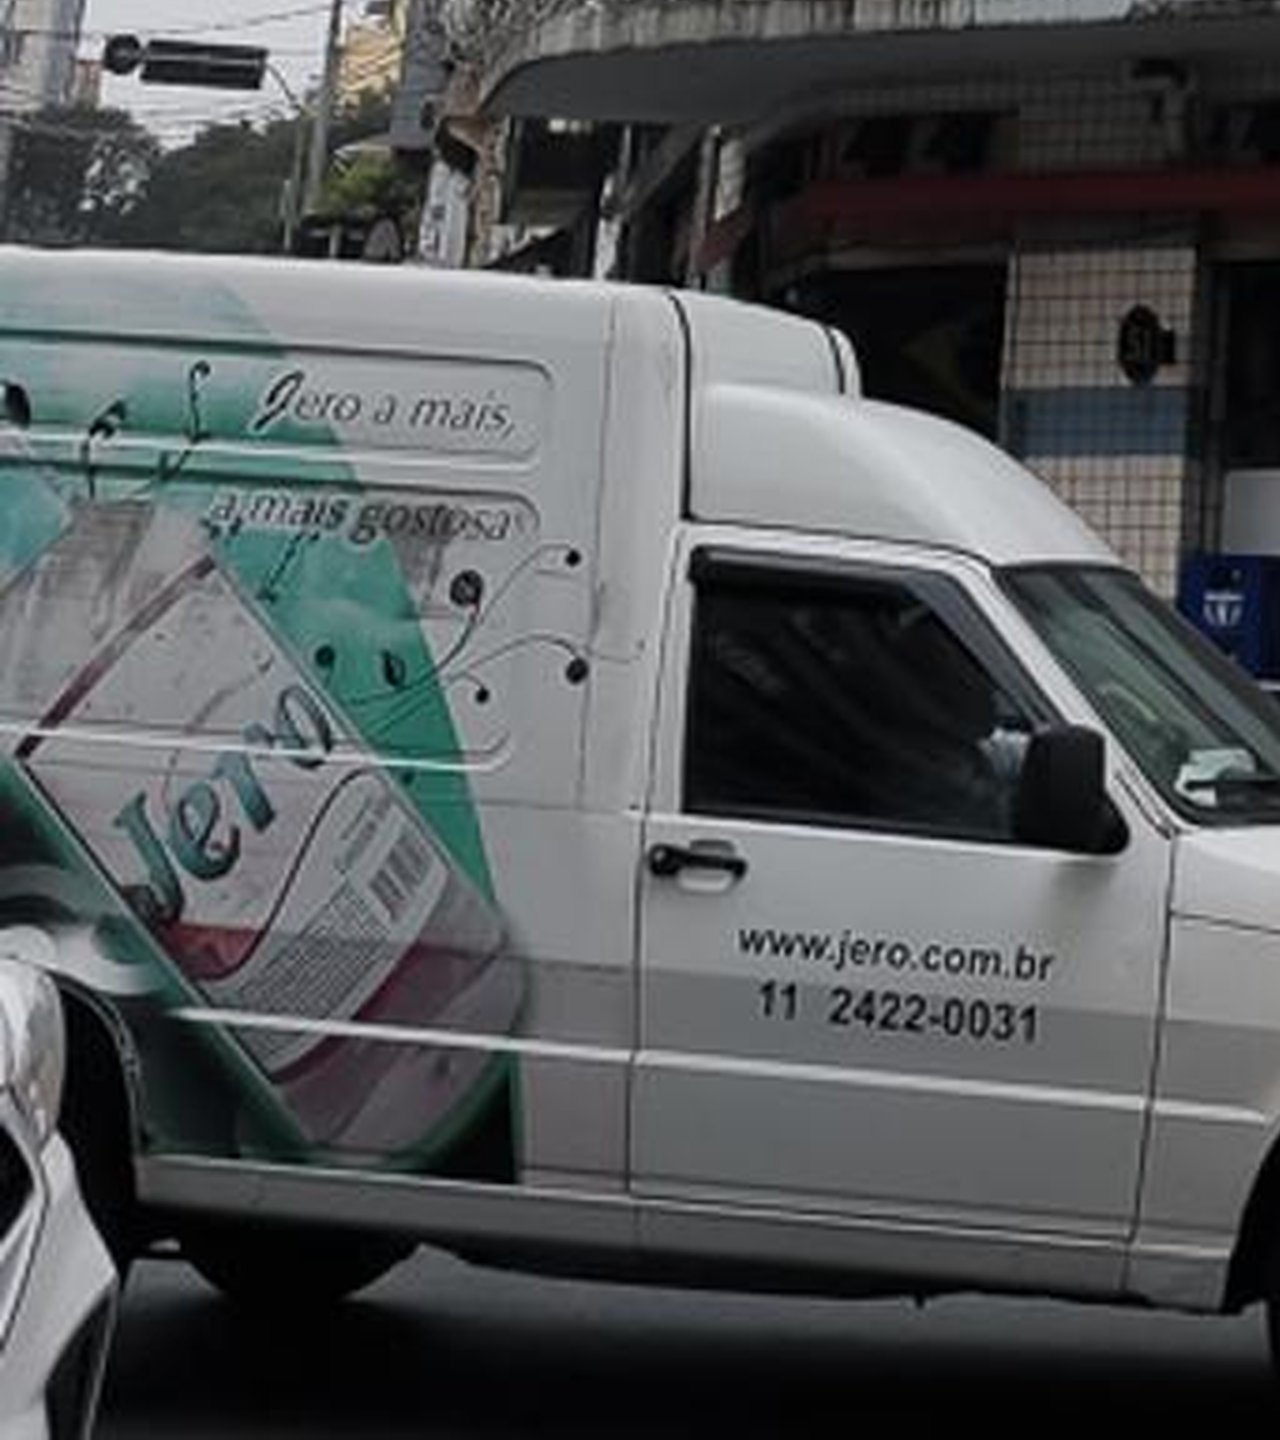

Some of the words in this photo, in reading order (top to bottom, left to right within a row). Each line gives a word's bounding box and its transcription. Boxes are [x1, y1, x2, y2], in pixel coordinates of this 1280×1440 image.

[253, 370, 362, 432] Jero
[373, 395, 397, 422] a
[247, 489, 348, 530] mais
[350, 498, 511, 545] gostosa
[112, 685, 334, 926] Jero
[738, 927, 1055, 982] www.jero.com.br
[759, 980, 798, 1021] 11
[829, 985, 1038, 1043] 2422-0031
